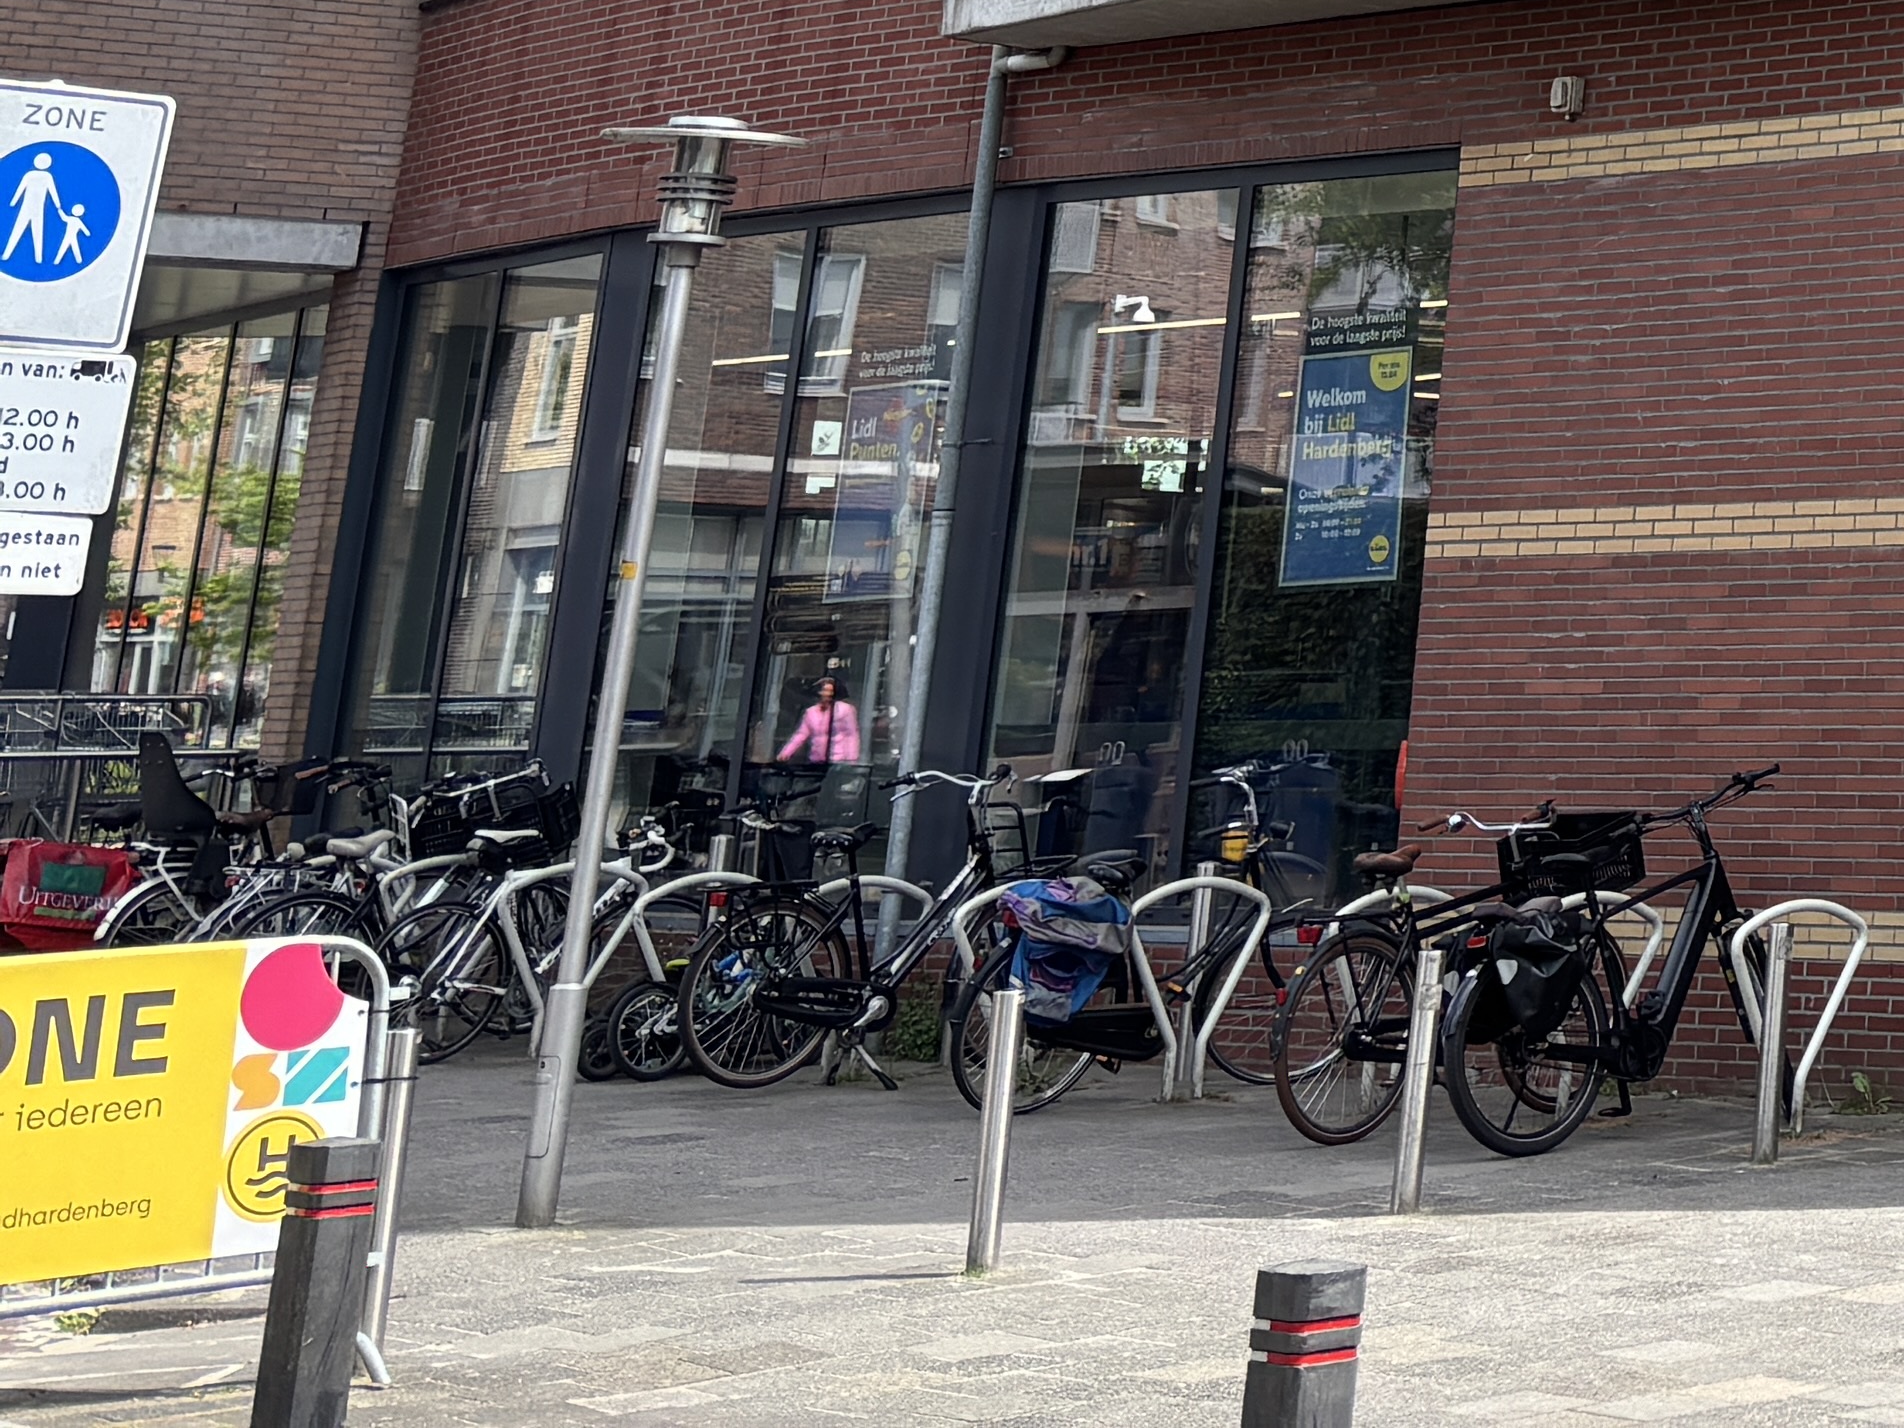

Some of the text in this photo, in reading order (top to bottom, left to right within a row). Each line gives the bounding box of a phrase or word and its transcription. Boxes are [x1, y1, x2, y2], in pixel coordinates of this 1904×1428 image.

[22, 103, 107, 132] ZONE
[1312, 316, 1325, 330] De
[1333, 332, 1344, 344] de
[22, 363, 65, 379] van:
[1307, 388, 1366, 408] Welkom
[66, 411, 79, 429] h
[851, 417, 877, 439] Lidl
[1304, 412, 1356, 437] bij Lidl
[62, 435, 75, 453] h
[53, 482, 66, 501] h
[0, 530, 80, 549] gestaan
[21, 562, 61, 579] niet
[17, 1096, 163, 1132] iedereen
[2, 1198, 151, 1229] dhardenberg
